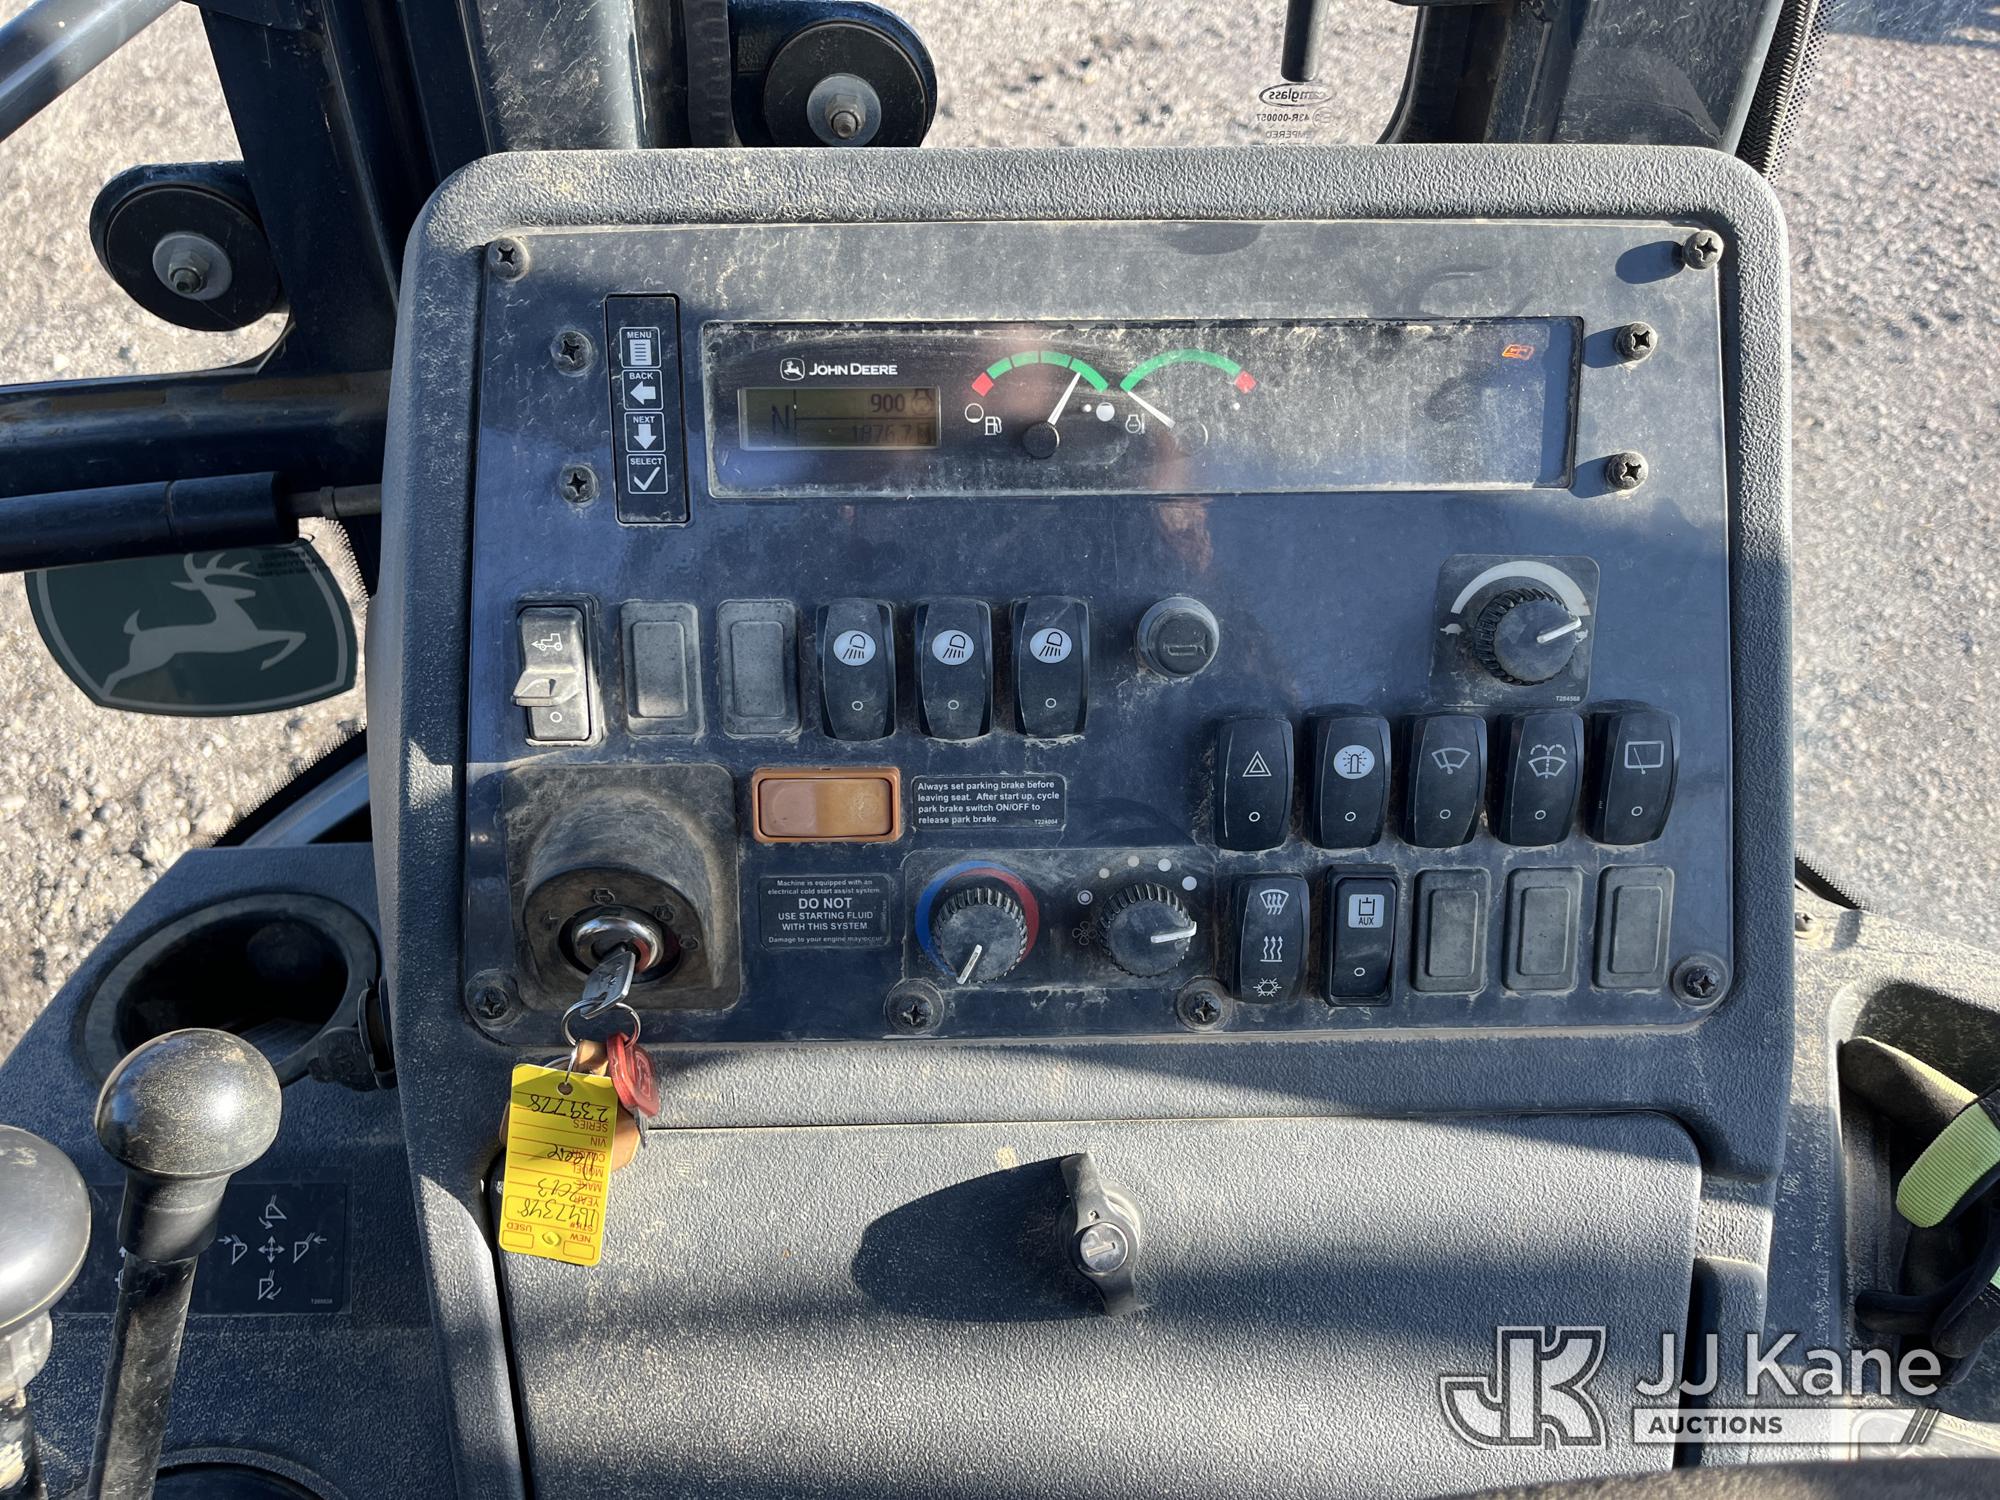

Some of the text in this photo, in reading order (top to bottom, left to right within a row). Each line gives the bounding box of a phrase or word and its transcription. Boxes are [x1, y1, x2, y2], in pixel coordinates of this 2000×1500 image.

[627, 331, 652, 339] MENU
[809, 363, 898, 376] JOHN DEERE
[629, 372, 654, 380] BACK
[871, 393, 905, 413] 900
[633, 416, 655, 424] NEXT
[771, 404, 790, 433] N
[630, 457, 662, 465] SELECT
[918, 782, 949, 791] Always
[966, 782, 999, 791] parking
[1000, 781, 1025, 789] brake
[1027, 780, 1055, 789] before
[918, 794, 949, 803] leaving
[976, 793, 997, 801] After
[1021, 794, 1035, 802] up,
[1036, 792, 1060, 801] cycle
[918, 803, 1041, 814] park brake switch ON/OFF to
[918, 815, 999, 825] release park brake.
[815, 880, 847, 888] equipped
[798, 897, 853, 910] DO NOT
[778, 911, 874, 921] USE STARTING FLUID
[782, 922, 868, 931] WITH THIS SYSTEM
[1358, 917, 1375, 926] AUX
[823, 936, 846, 944] engine
[573, 1120, 608, 1133] SERIES
[590, 1137, 607, 1147] VIN
[537, 1178, 587, 1202] 2013
[574, 1196, 599, 1207] YEAR
[506, 1222, 533, 1232] USED
[570, 1233, 591, 1243] NEW
